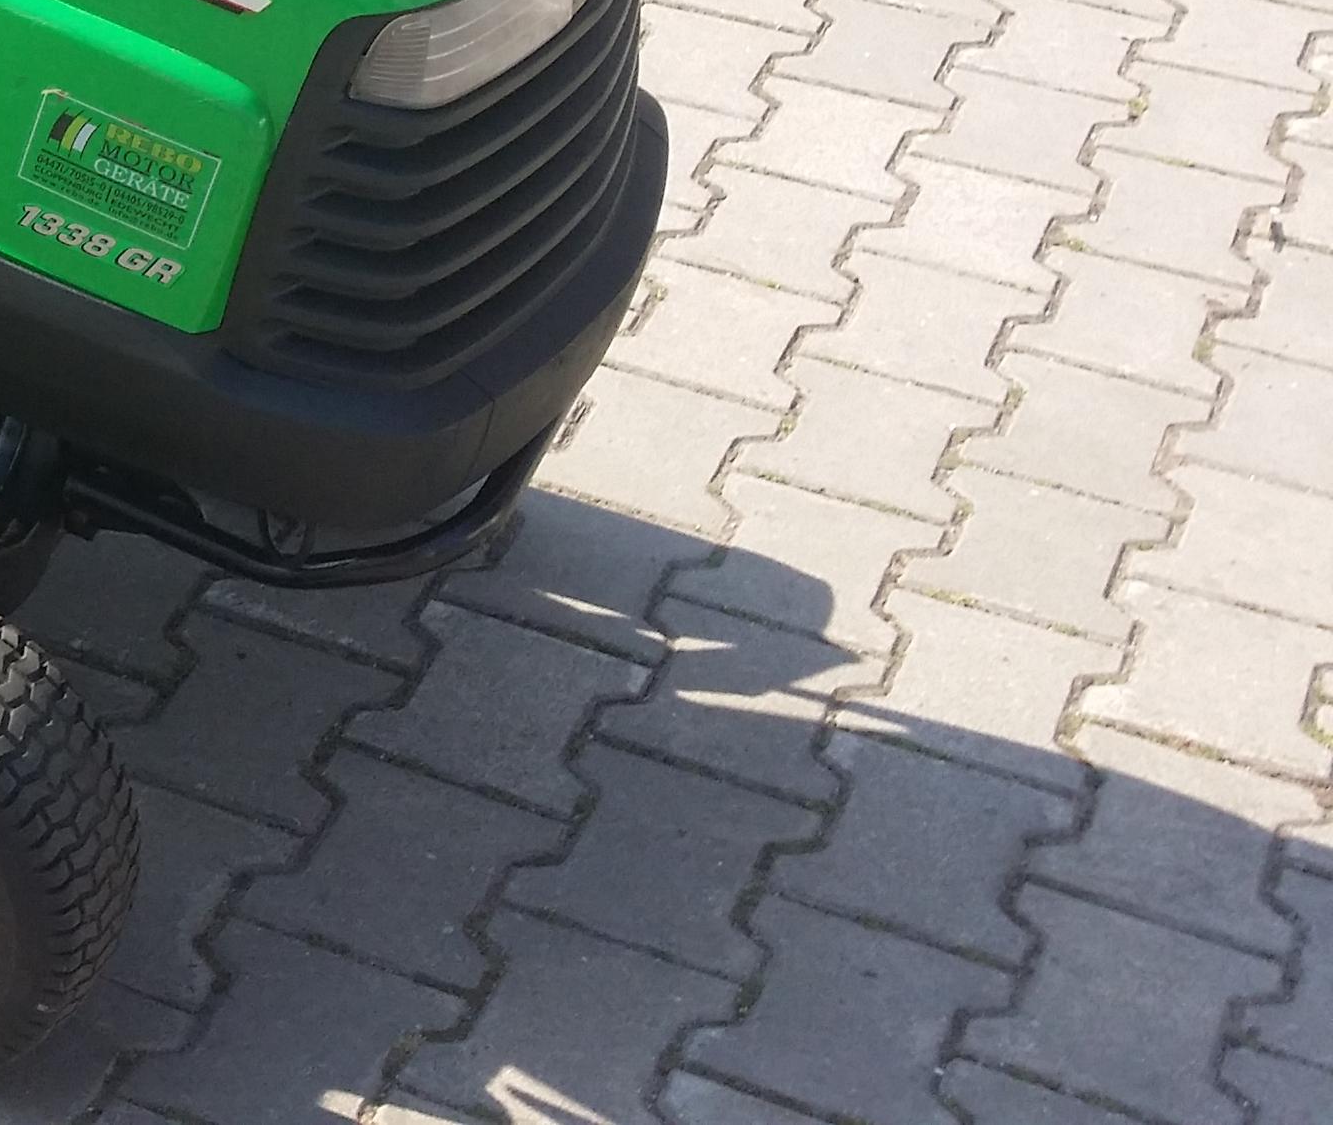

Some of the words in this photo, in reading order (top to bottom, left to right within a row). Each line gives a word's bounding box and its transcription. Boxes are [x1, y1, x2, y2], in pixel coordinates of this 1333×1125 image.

[100, 139, 196, 189] MOTOR
[106, 124, 202, 174] REBO
[93, 158, 191, 209] GERÄTE
[18, 205, 117, 257] 1338
[115, 247, 183, 284] GR
